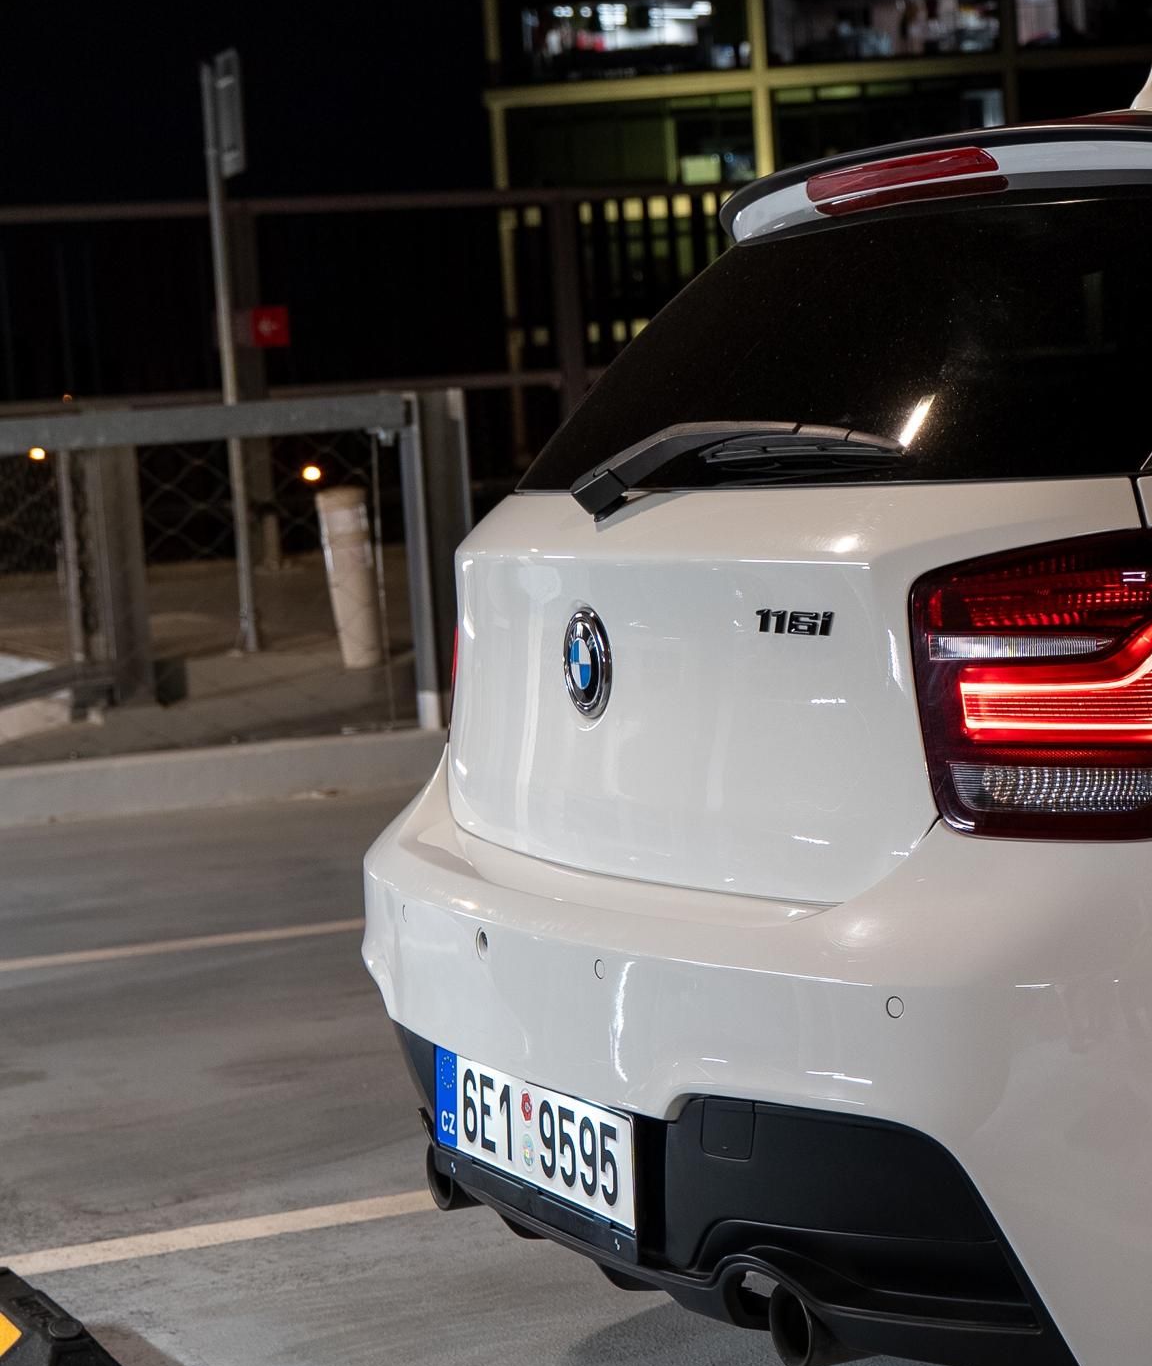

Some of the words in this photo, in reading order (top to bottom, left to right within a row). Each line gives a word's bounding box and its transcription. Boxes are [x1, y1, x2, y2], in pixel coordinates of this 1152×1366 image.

[755, 608, 835, 636] 116i
[441, 1110, 456, 1136] CZ
[463, 1068, 513, 1162] 6E1
[539, 1099, 618, 1207] 9595
